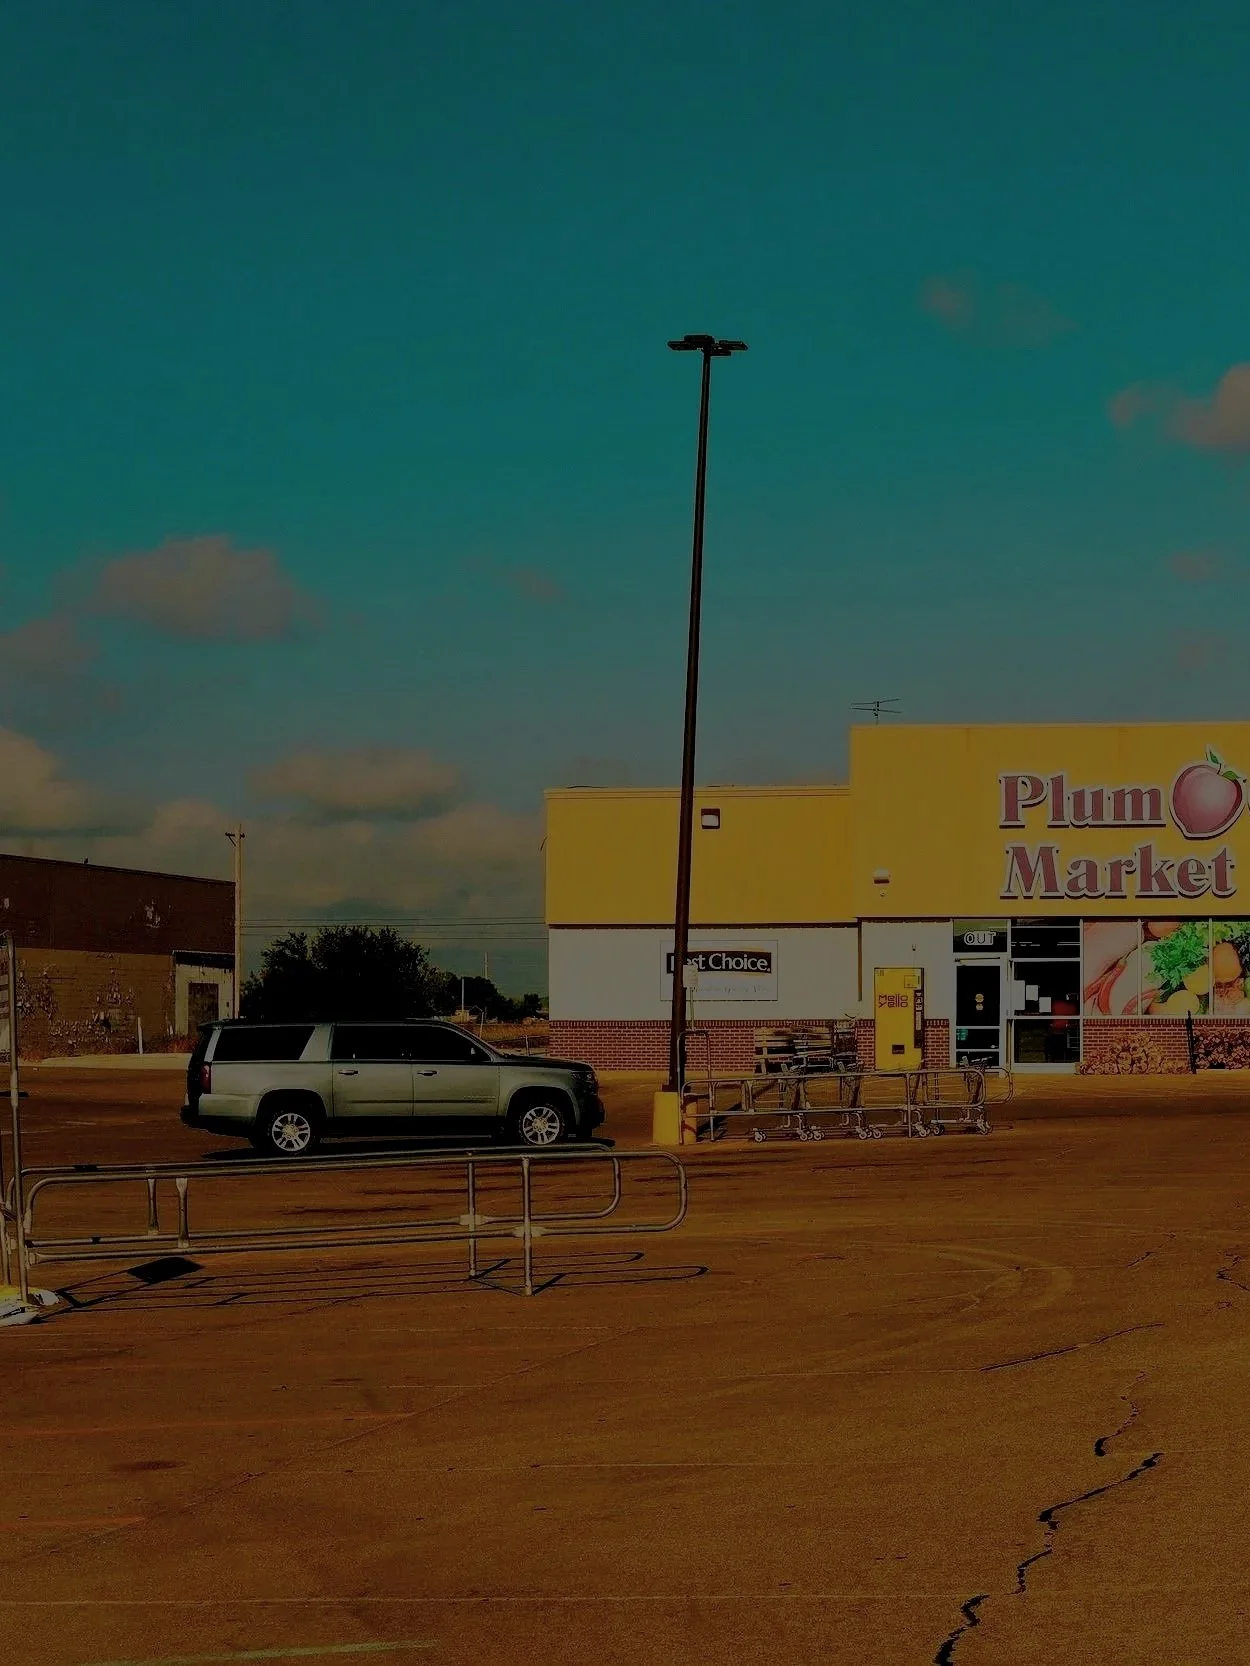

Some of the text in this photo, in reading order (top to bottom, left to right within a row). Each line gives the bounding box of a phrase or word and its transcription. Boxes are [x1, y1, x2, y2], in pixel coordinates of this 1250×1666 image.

[1000, 773, 1166, 828] Plum
[1000, 842, 1238, 898] Market
[965, 931, 996, 945] OUT
